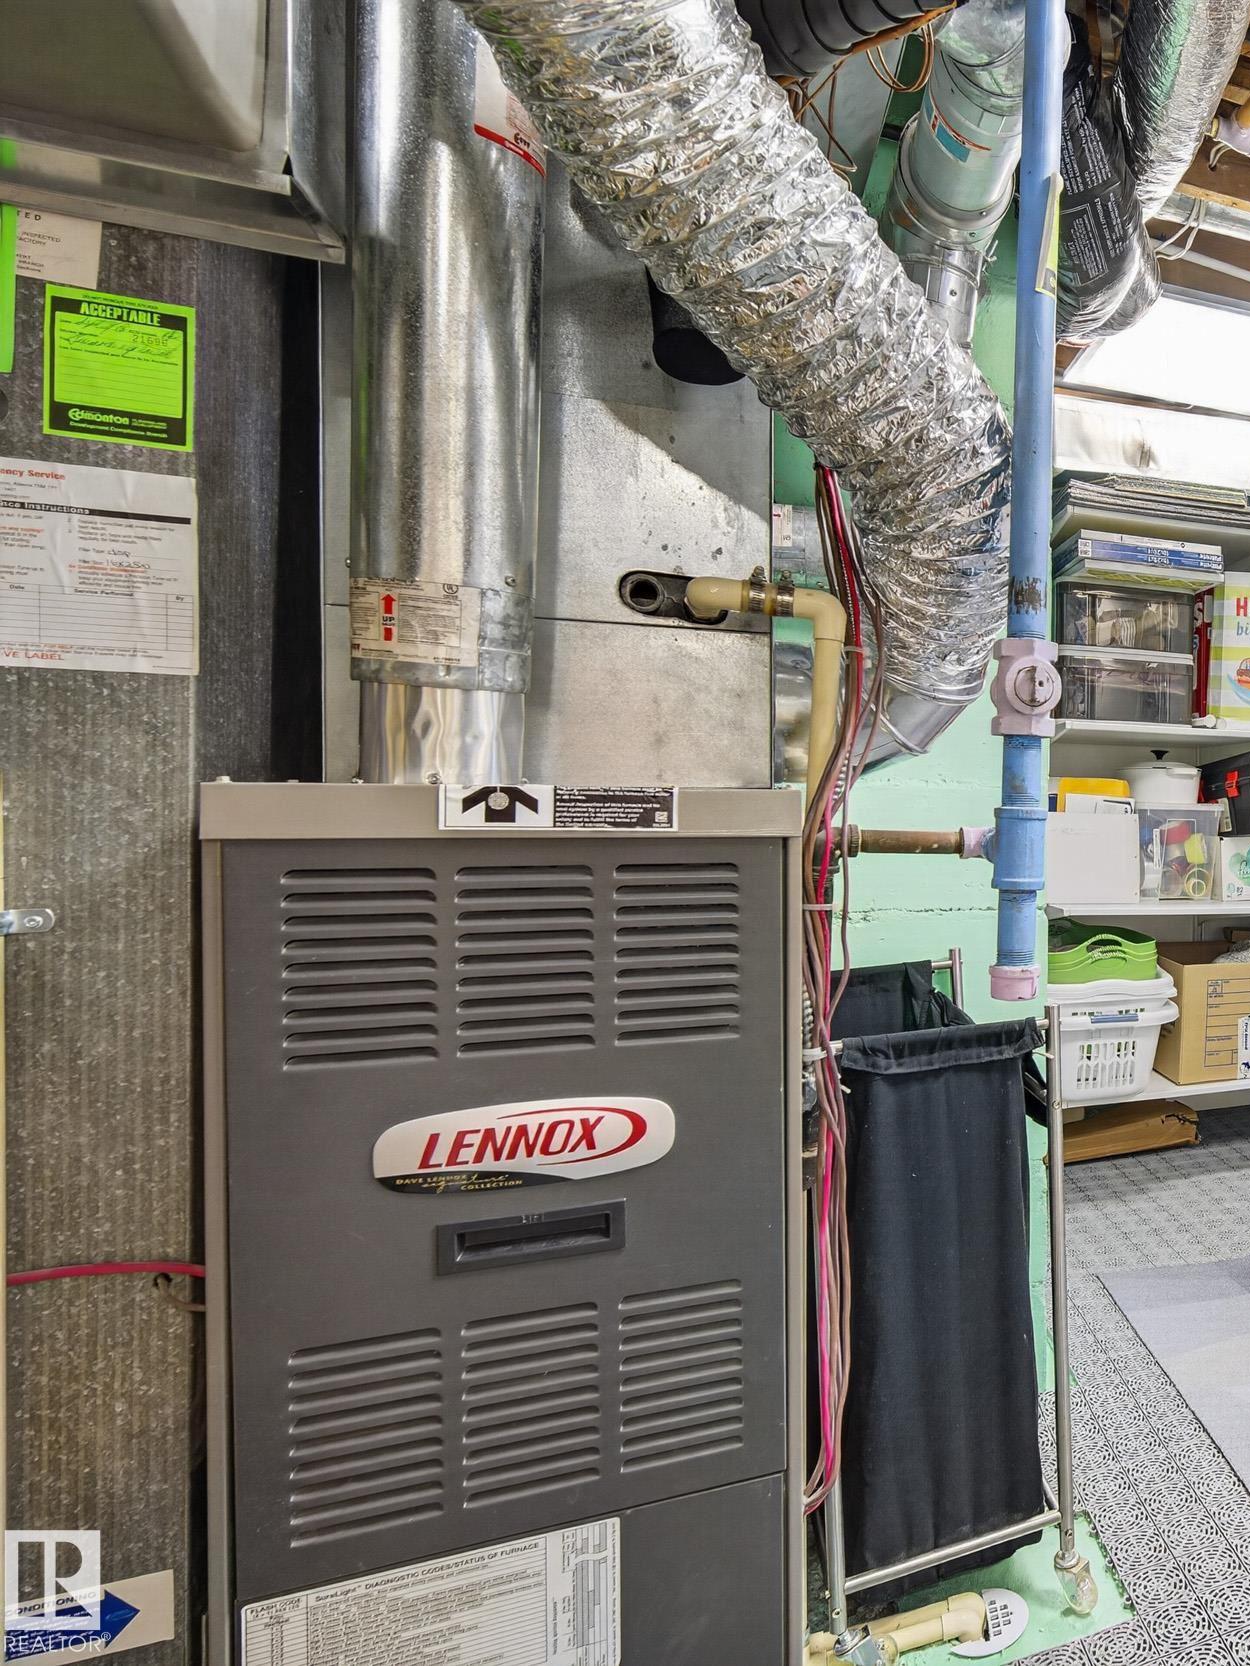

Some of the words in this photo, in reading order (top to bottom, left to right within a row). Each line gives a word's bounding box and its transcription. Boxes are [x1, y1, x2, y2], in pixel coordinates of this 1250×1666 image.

[80, 301, 161, 327] ACCEPTABLE
[68, 407, 130, 425] Edmonton
[28, 469, 65, 481] Service
[24, 502, 90, 515] Instructions
[382, 615, 396, 624] UP
[24, 651, 65, 662] LABEL
[417, 1115, 605, 1170] LENNOX
[395, 1178, 423, 1186] DAVE
[460, 1180, 523, 1191] COLLECTION
[364, 1570, 420, 1590] DIAGNOSTIC
[499, 1541, 540, 1557] FURNACE
